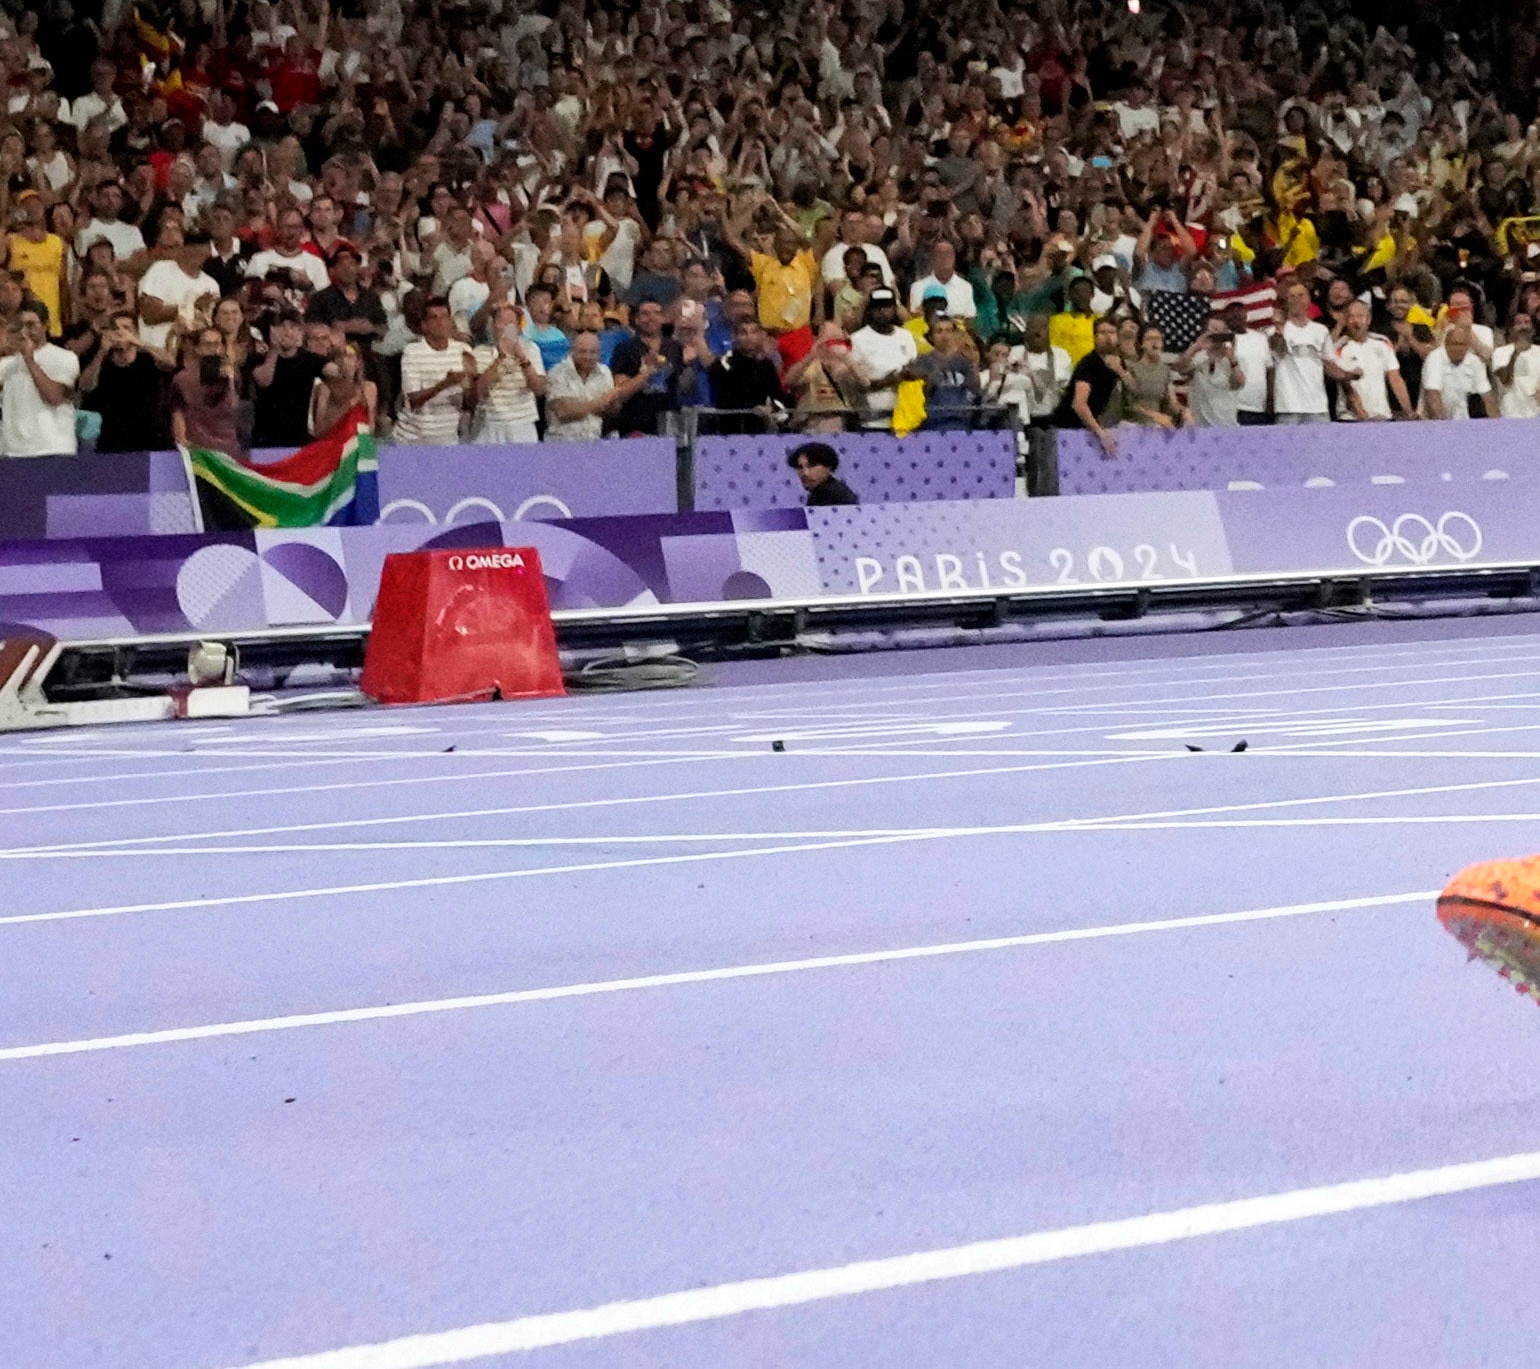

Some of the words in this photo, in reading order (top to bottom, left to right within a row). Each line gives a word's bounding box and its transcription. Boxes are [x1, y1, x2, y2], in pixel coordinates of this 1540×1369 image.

[465, 552, 525, 570] OMEGA
[855, 550, 1028, 595] PARIS
[1048, 542, 1199, 586] 2024
